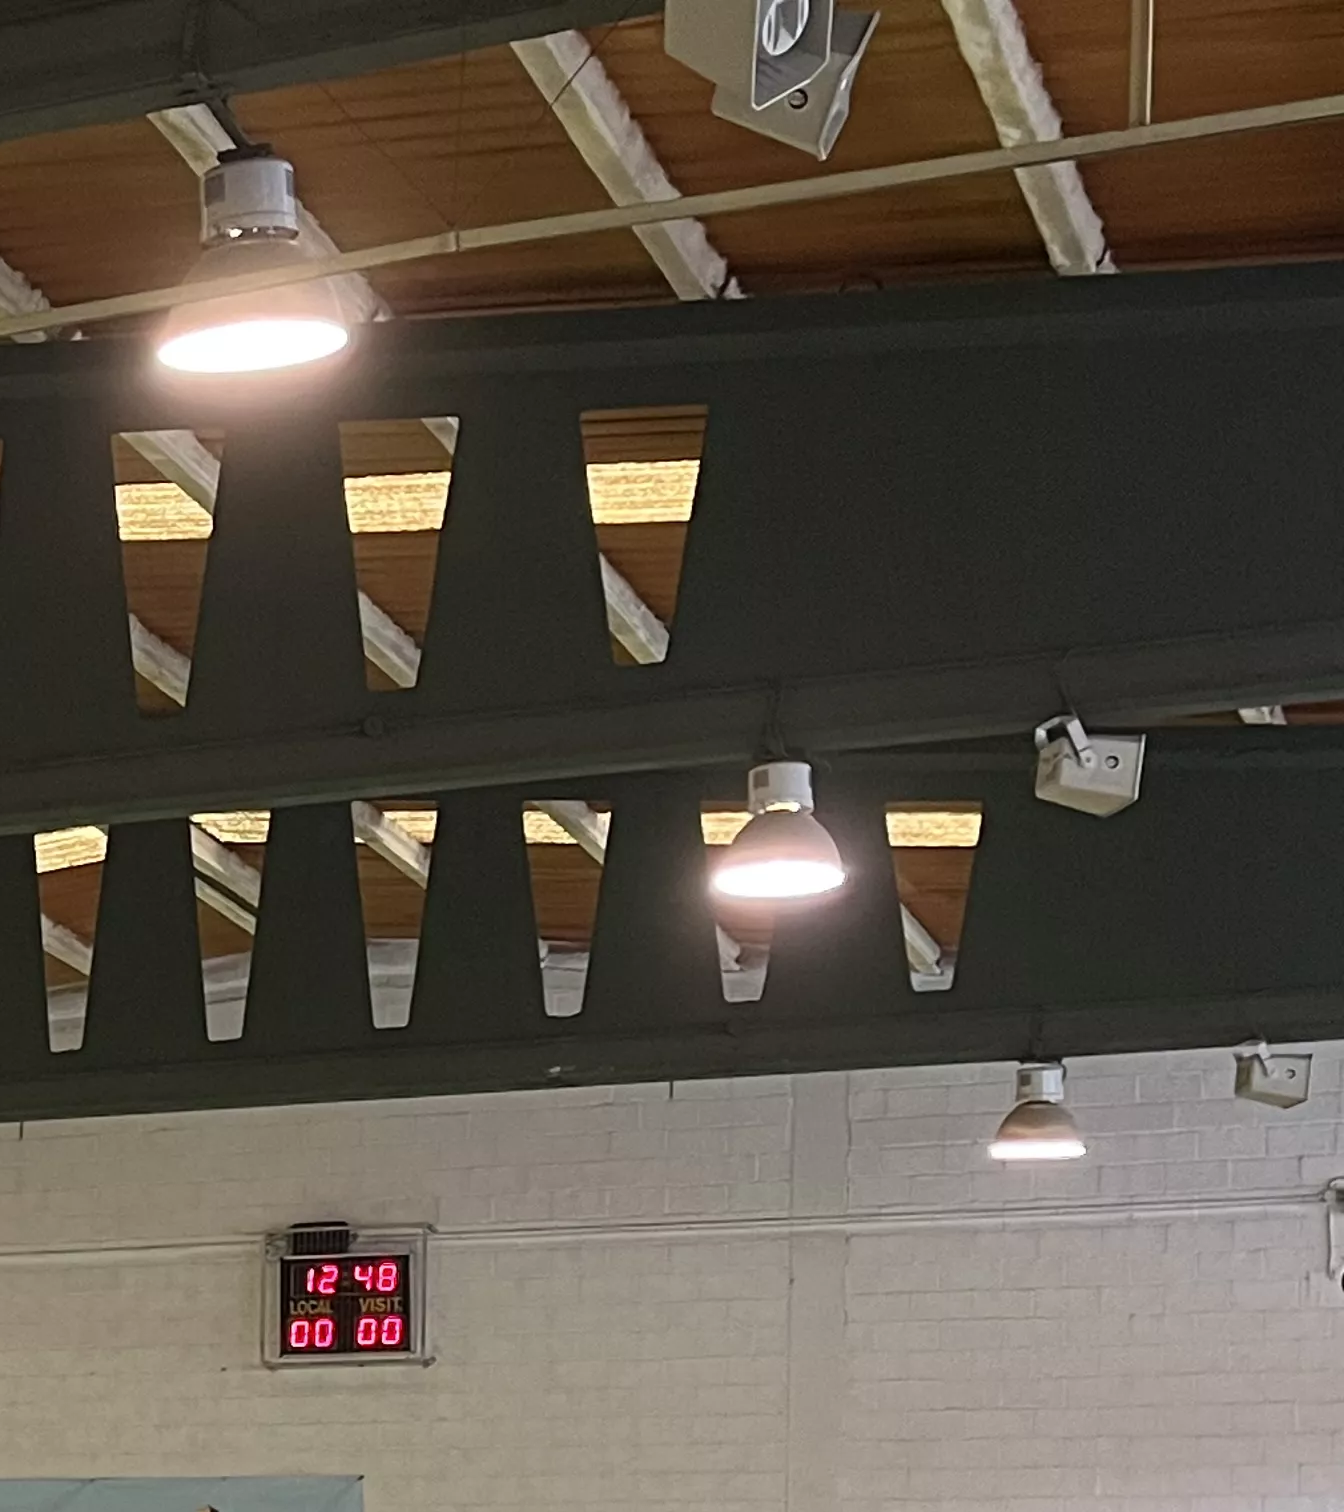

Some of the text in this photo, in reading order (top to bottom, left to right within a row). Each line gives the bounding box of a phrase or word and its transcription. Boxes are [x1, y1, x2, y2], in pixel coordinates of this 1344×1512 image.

[289, 1299, 334, 1315] LOCAL
[290, 1316, 403, 1348] 00 00
